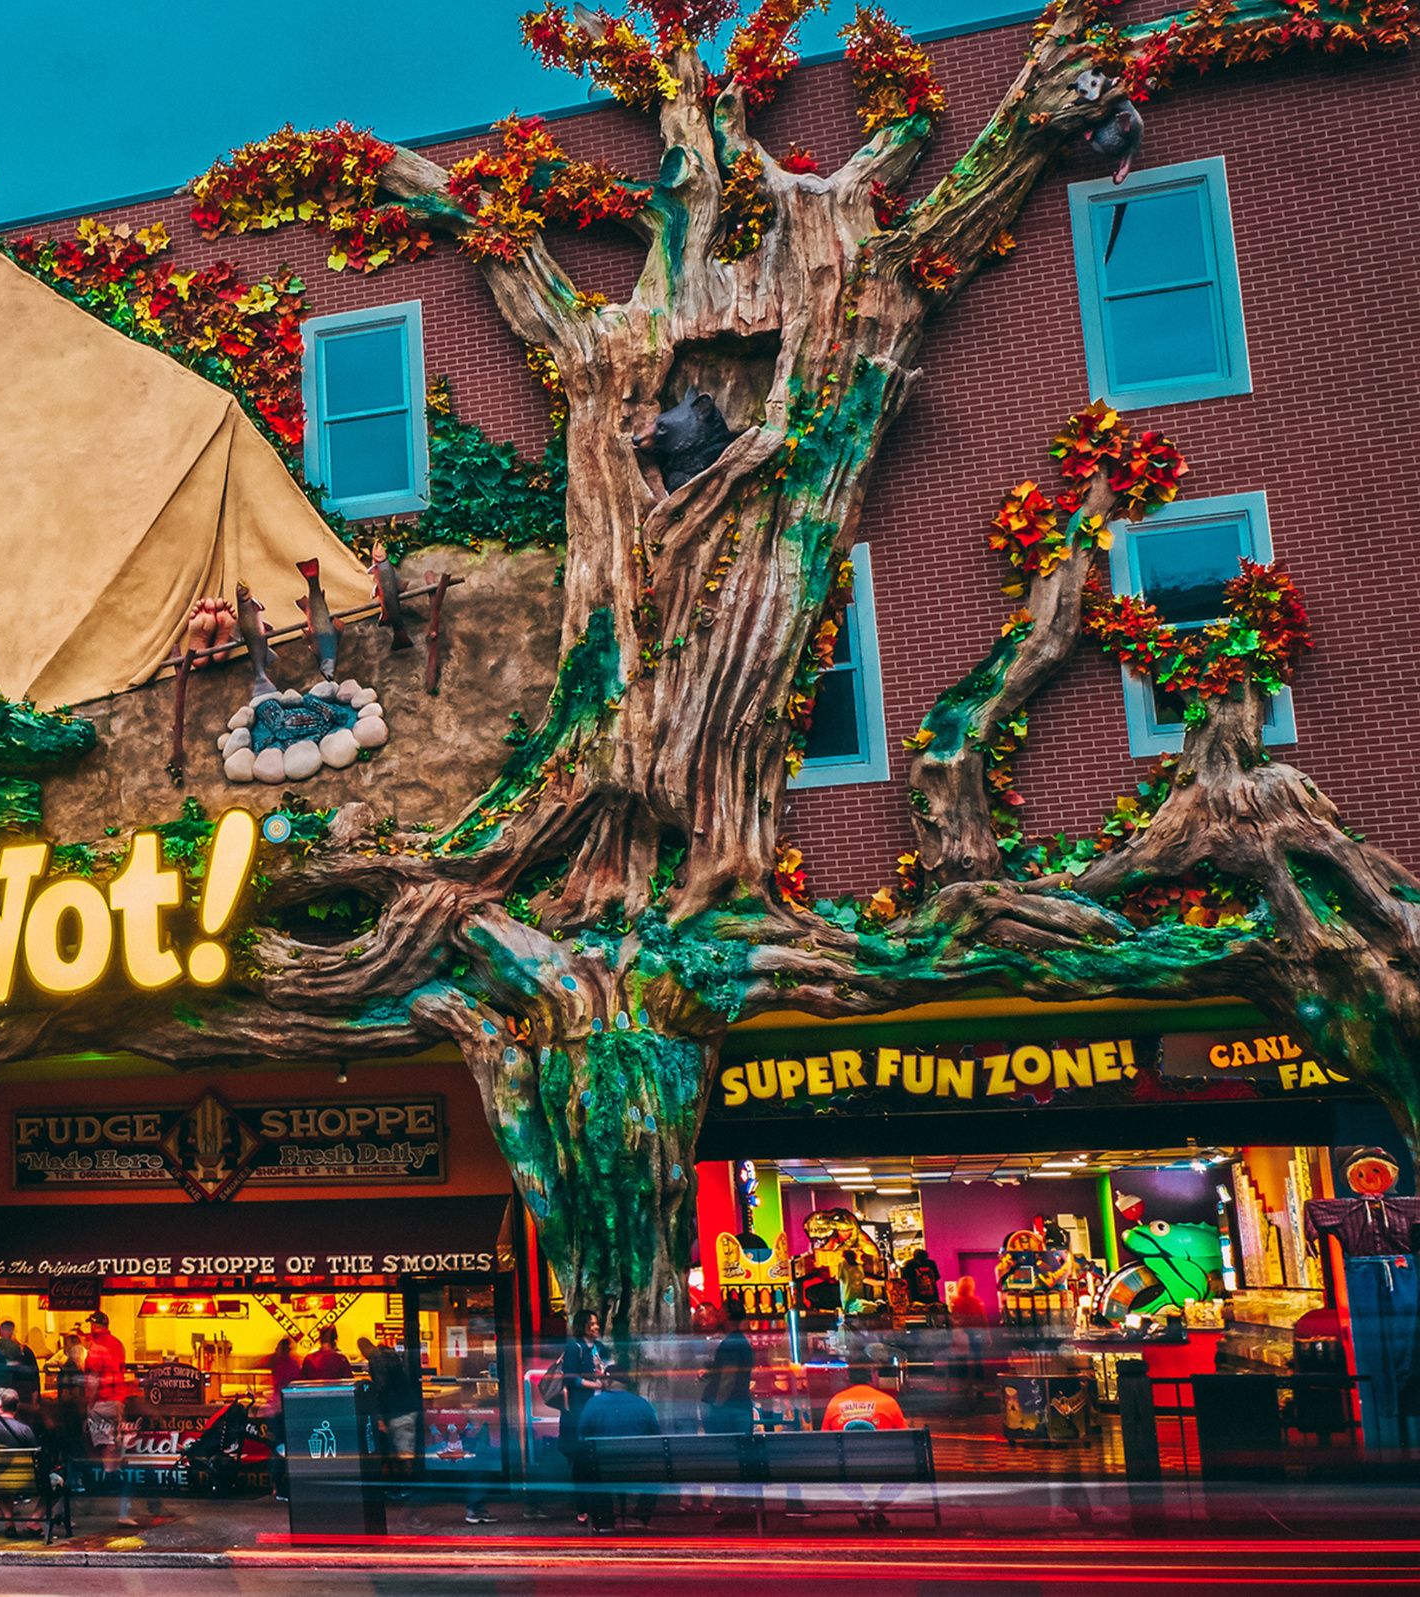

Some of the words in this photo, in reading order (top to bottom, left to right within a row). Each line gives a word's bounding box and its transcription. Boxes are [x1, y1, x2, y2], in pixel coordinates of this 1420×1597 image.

[720, 1049, 868, 1107] SUPER
[876, 1047, 975, 1100] FUN
[983, 1039, 1139, 1096] ZONE!
[17, 1113, 162, 1145] FUDGE
[260, 1104, 435, 1138] SHOPPE
[95, 1150, 164, 1170] Here
[280, 1143, 353, 1166] Fresh
[55, 1171, 74, 1179] THE
[79, 1170, 124, 1179] ORIGINAL
[129, 1169, 166, 1179] FUDGE
[256, 1166, 300, 1176] SHOPPE
[304, 1165, 320, 1175] OF
[325, 1164, 348, 1175] THE
[184, 1181, 203, 1201] THE
[8, 1260, 35, 1275] The
[38, 1260, 97, 1277] Original
[97, 1257, 172, 1275] FUDGE
[180, 1256, 275, 1275] SHOPPE
[285, 1256, 316, 1274] OF
[327, 1255, 374, 1275] THE
[382, 1252, 494, 1274] SMOKIES
[273, 1308, 301, 1338] THE
